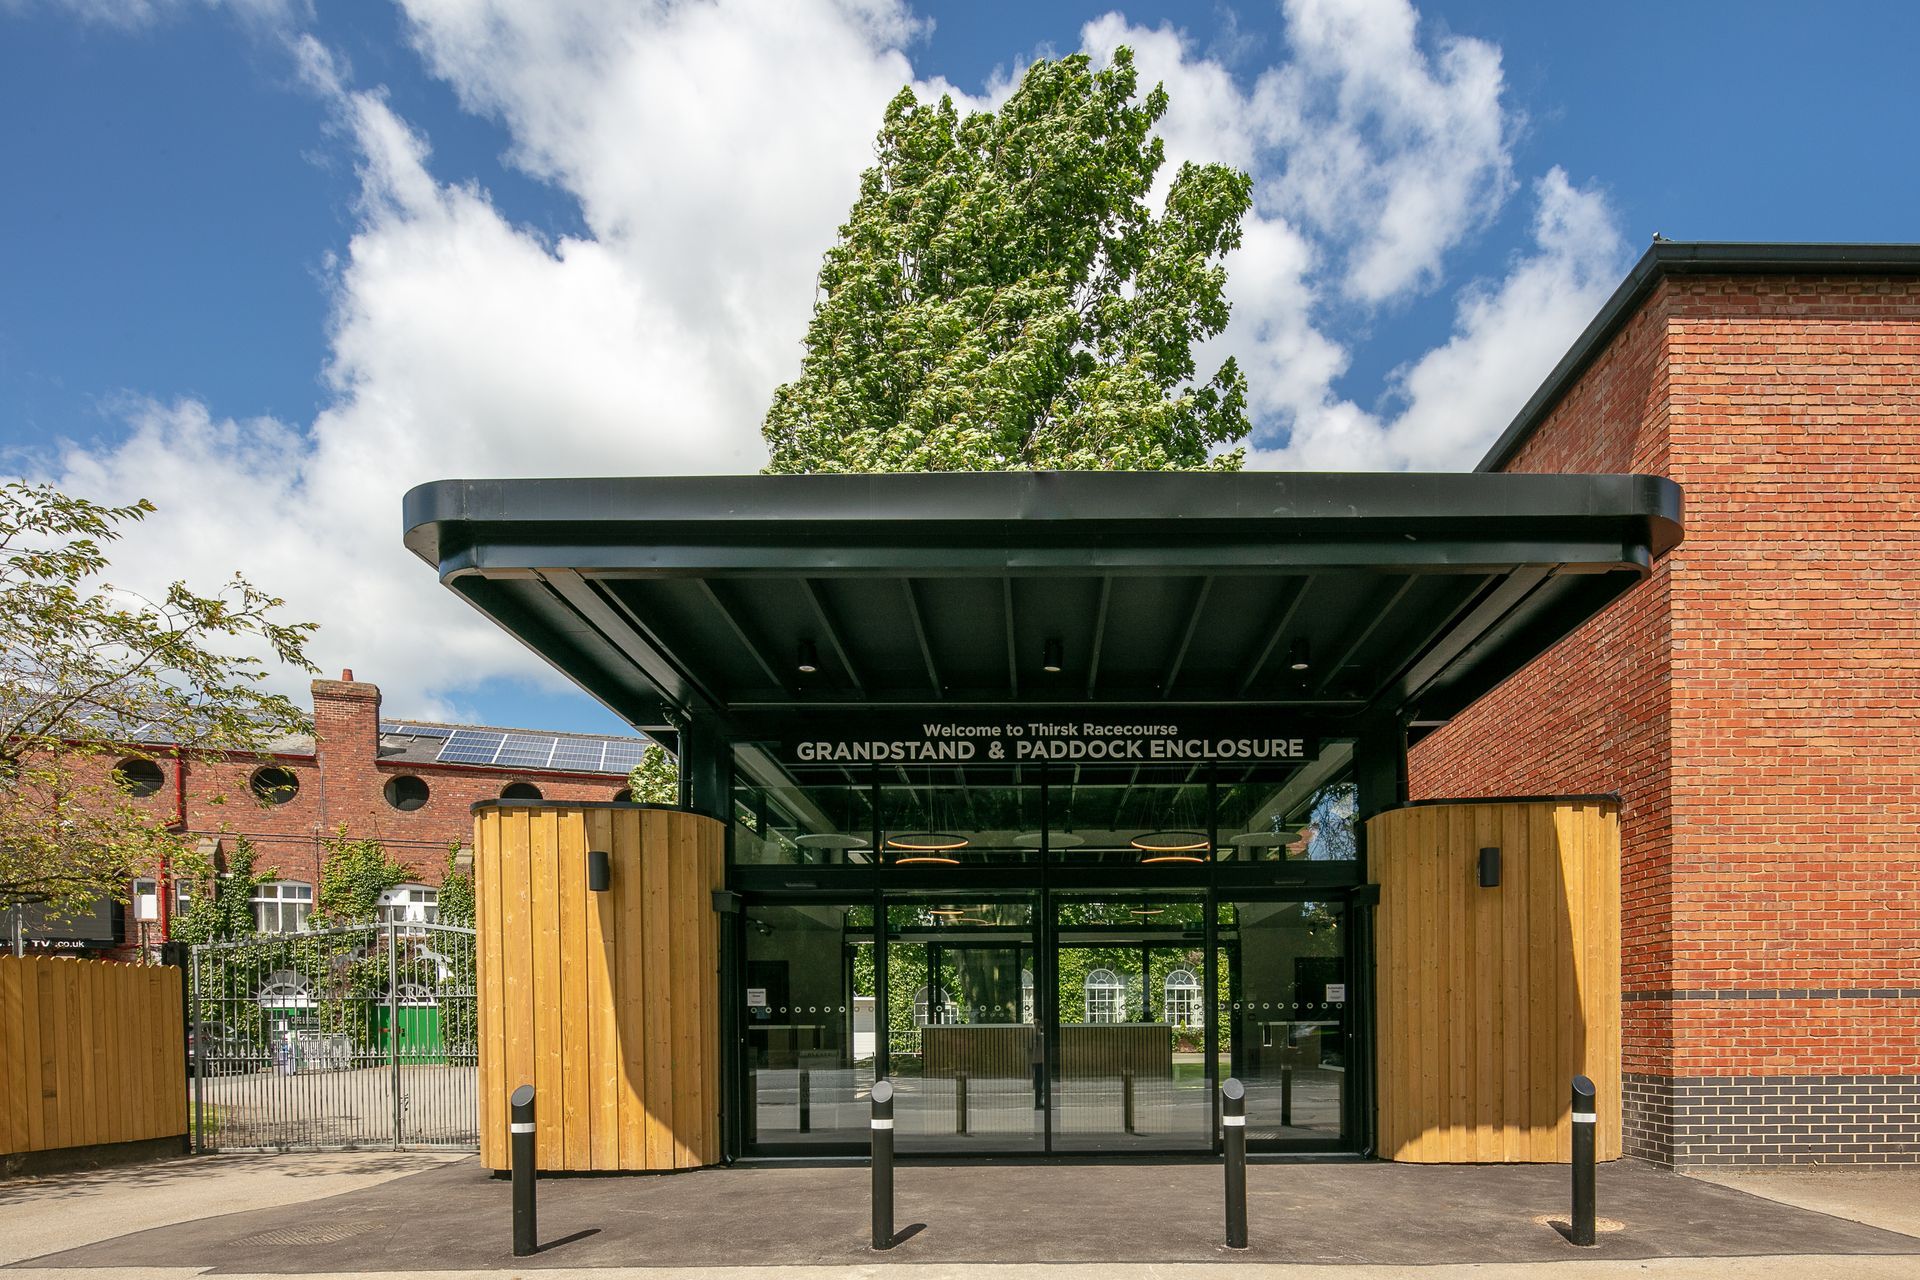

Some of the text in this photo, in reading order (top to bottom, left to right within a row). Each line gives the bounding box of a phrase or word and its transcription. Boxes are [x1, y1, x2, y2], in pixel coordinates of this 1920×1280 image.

[923, 723, 1178, 737] Welcome to Thirsk Racecourse
[796, 738, 1304, 760] GRANDSTAND & PADDOCK ENCLOSURE
[408, 985, 477, 997] RACECOU
